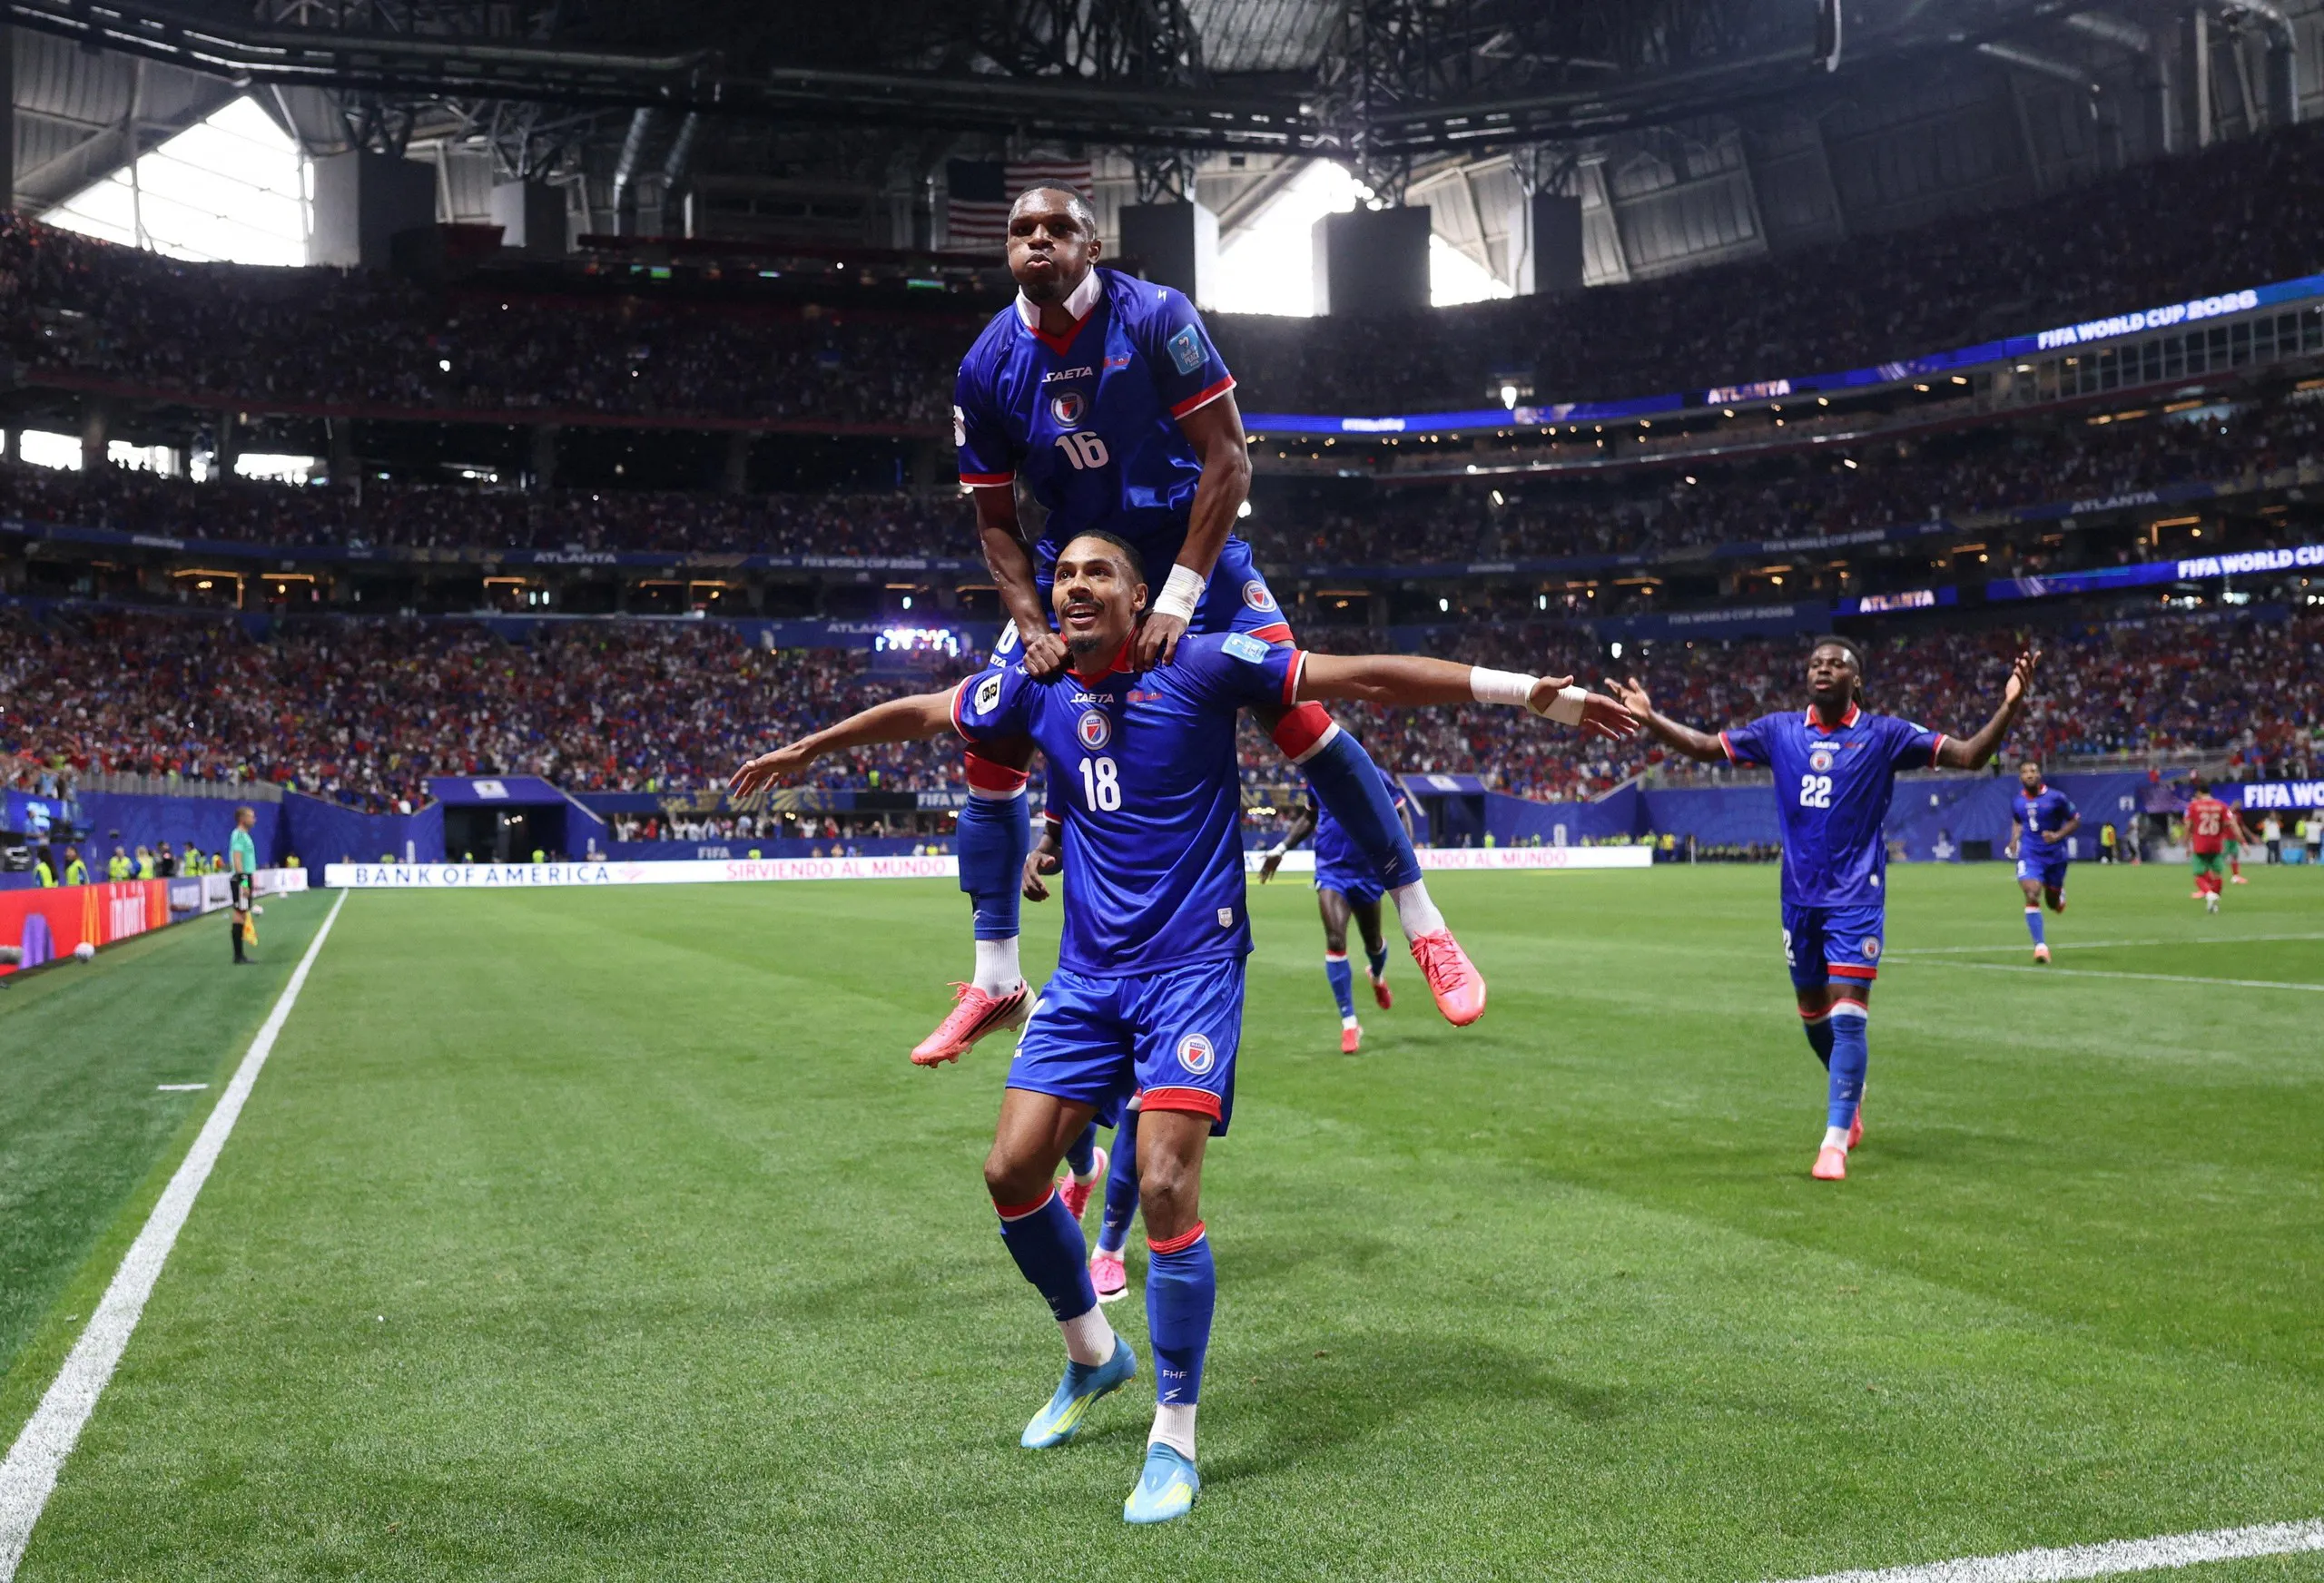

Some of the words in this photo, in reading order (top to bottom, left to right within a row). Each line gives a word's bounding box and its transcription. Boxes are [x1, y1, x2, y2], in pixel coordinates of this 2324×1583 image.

[2038, 327, 2077, 350] FIFA
[2077, 313, 2145, 342] WORLD
[2146, 304, 2185, 328] CUP
[1041, 366, 1093, 382] SAETA
[1055, 431, 1109, 470] 16
[533, 551, 616, 563] ATLANTA
[2178, 556, 2221, 579] FIFA
[2221, 549, 2294, 574] WORLD
[2295, 545, 2324, 565] CU
[1070, 693, 1115, 703] SAETA
[1078, 757, 1122, 812] 18
[1799, 774, 1833, 809] 22
[2243, 783, 2291, 808] FIFA
[2291, 782, 2324, 806] WO
[917, 792, 951, 807] FIFA
[697, 846, 730, 860] FIFA
[1420, 850, 1468, 869] ENDO
[1502, 848, 1569, 868] MUNDO
[356, 868, 430, 883] BANK
[443, 867, 474, 883] OF
[486, 866, 610, 884] AMERICA
[726, 860, 834, 880] SIRVIENDO
[842, 860, 865, 880] AL
[872, 859, 946, 878] MUNDO
[1782, 928, 1795, 960] 2
[1163, 1369, 1188, 1379] FHF
